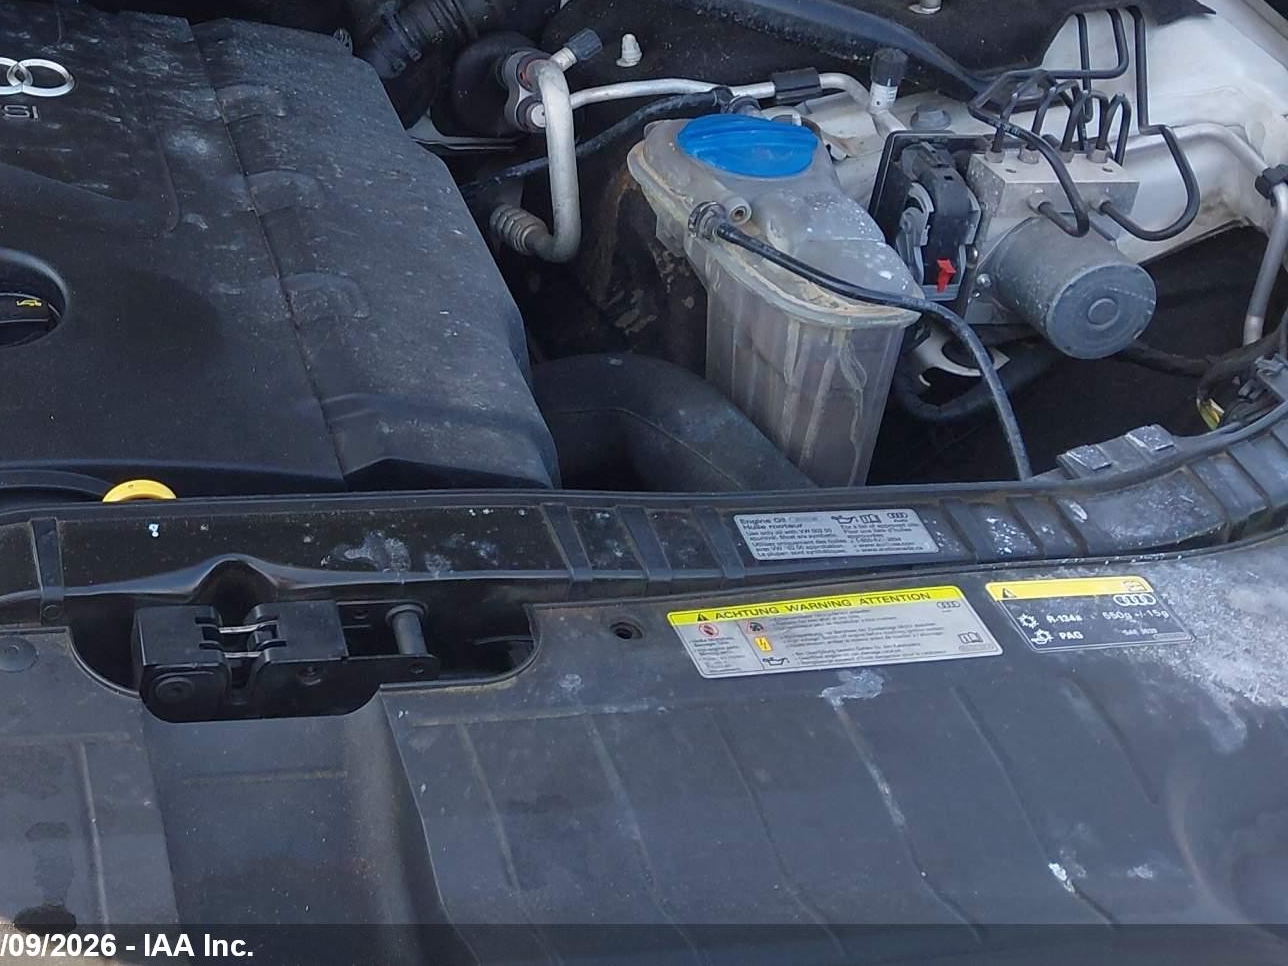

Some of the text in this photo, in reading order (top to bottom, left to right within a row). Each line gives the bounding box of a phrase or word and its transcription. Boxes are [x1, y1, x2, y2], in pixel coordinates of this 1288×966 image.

[714, 605, 780, 621] ACHTUNG
[784, 598, 853, 613] WARNING
[858, 591, 932, 606] ATTENTION
[1058, 630, 1084, 640] PAG
